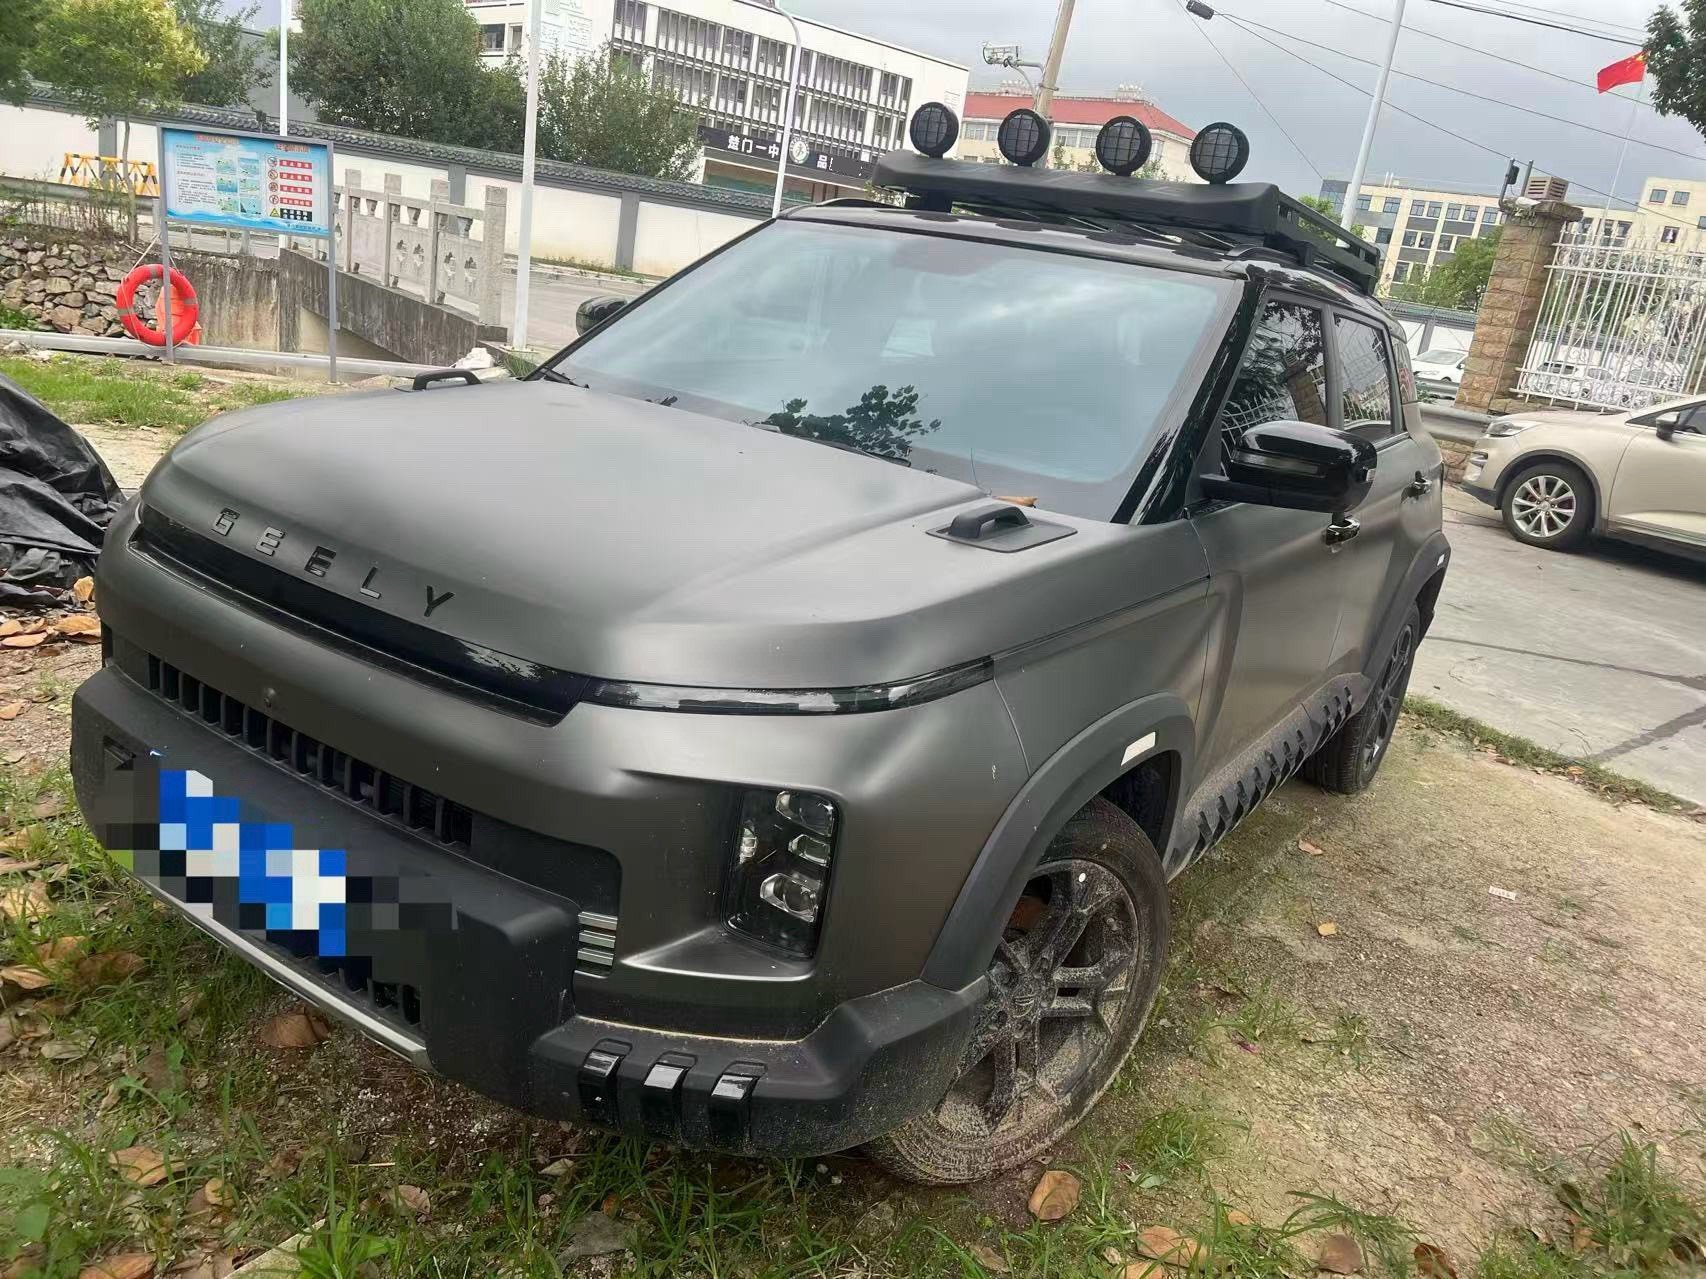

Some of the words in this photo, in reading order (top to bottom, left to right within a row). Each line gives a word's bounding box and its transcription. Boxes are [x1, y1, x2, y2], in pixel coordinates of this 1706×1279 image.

[727, 135, 780, 159] 楚门一中
[211, 507, 455, 617] GEELY
